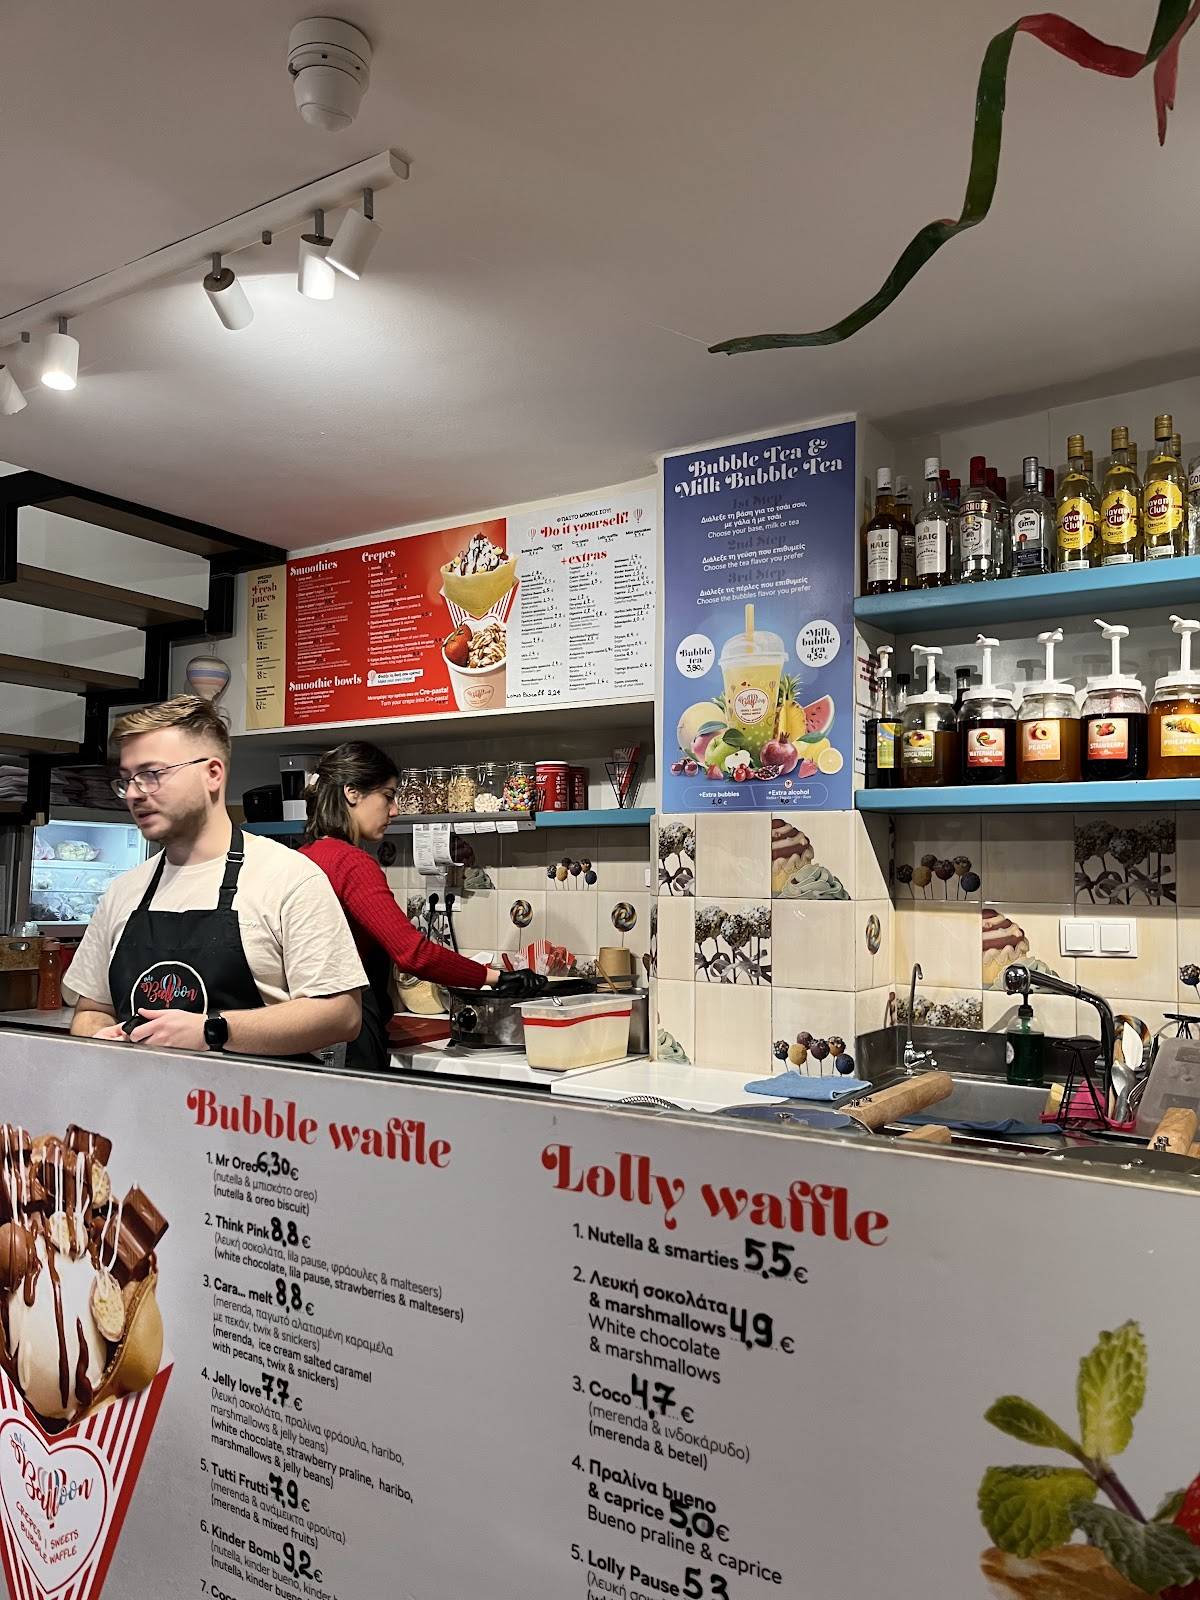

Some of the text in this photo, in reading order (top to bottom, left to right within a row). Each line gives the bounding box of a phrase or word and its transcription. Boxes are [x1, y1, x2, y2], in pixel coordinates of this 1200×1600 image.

[674, 458, 842, 498] Milk Bubble Tea
[688, 438, 827, 477] Bubble Tea &
[540, 526, 559, 538] Do
[563, 523, 570, 534] it
[573, 512, 629, 536] yourself!
[1150, 505, 1167, 514] Club
[708, 529, 731, 539] Choose
[732, 527, 746, 536] your
[748, 525, 764, 533] base,
[917, 533, 938, 542] HAIG
[290, 560, 338, 576] Smoothies
[362, 550, 396, 563] Crepes
[252, 582, 276, 594] Fresh
[252, 594, 276, 607] juices
[289, 677, 332, 691] Smoothie
[335, 674, 362, 686] bowls
[186, 1088, 452, 1168] Bubble waffle
[206, 1152, 212, 1164] 1.
[216, 1153, 229, 1166] Mr
[232, 1156, 258, 1172] Oreo
[214, 1184, 309, 1216] (nutella & oreo biscuit)
[541, 1144, 889, 1246] Lolly waffle
[205, 1213, 212, 1226] 2.
[216, 1215, 243, 1233] Think
[247, 1222, 269, 1239] Pink
[573, 1224, 583, 1239] 1.
[588, 1226, 643, 1251] Nutella
[648, 1238, 660, 1254] &
[665, 1244, 739, 1270] smarties
[203, 1274, 211, 1288] 3.
[249, 1290, 273, 1305] melt
[215, 1247, 464, 1323] (white chocolate, lila pause, strawberries & maltesers)
[573, 1266, 728, 1314] 2. Λευκή σοκολάτα
[589, 1313, 720, 1360] White chocolate
[590, 1292, 600, 1307] &
[605, 1299, 726, 1338] marshmallows
[212, 1341, 338, 1390] with pecans, twix & snickers)
[213, 1324, 371, 1383] (merenda, ice cream salted caramel
[590, 1336, 720, 1384] & marshmallows
[201, 1367, 209, 1380] 4.
[213, 1371, 236, 1392] Jelly
[240, 1379, 261, 1397] love
[572, 1375, 584, 1393] 3.
[589, 1381, 631, 1406] Coco
[589, 1401, 750, 1464] (merenda & ινδοκάρυδο)
[589, 1420, 708, 1471] (merenda & betel)
[200, 1458, 208, 1472] 5.
[211, 1462, 236, 1483] Tutti
[239, 1473, 268, 1496] Frutti
[211, 1416, 413, 1503] (white chocolate, strawberry praline, haribo,
[211, 1434, 334, 1489] marshmallows & jelly beans)
[571, 1455, 716, 1514] 4. Πραλίνα bueno
[588, 1482, 600, 1499] &
[604, 1490, 664, 1520] caprice
[16, 1501, 78, 1549] CREPES SWEETS
[20, 1521, 77, 1564] BUBBLE WAFFLE
[200, 1520, 209, 1534] 6.
[212, 1524, 245, 1549] Kinder
[249, 1540, 281, 1564] Bomb
[211, 1494, 318, 1550] (merenda & mixed fruits)
[588, 1504, 783, 1584] Bueno praline & caprice
[571, 1544, 583, 1562] 5.
[588, 1550, 625, 1580] Lolly
[630, 1564, 680, 1597] Pause
